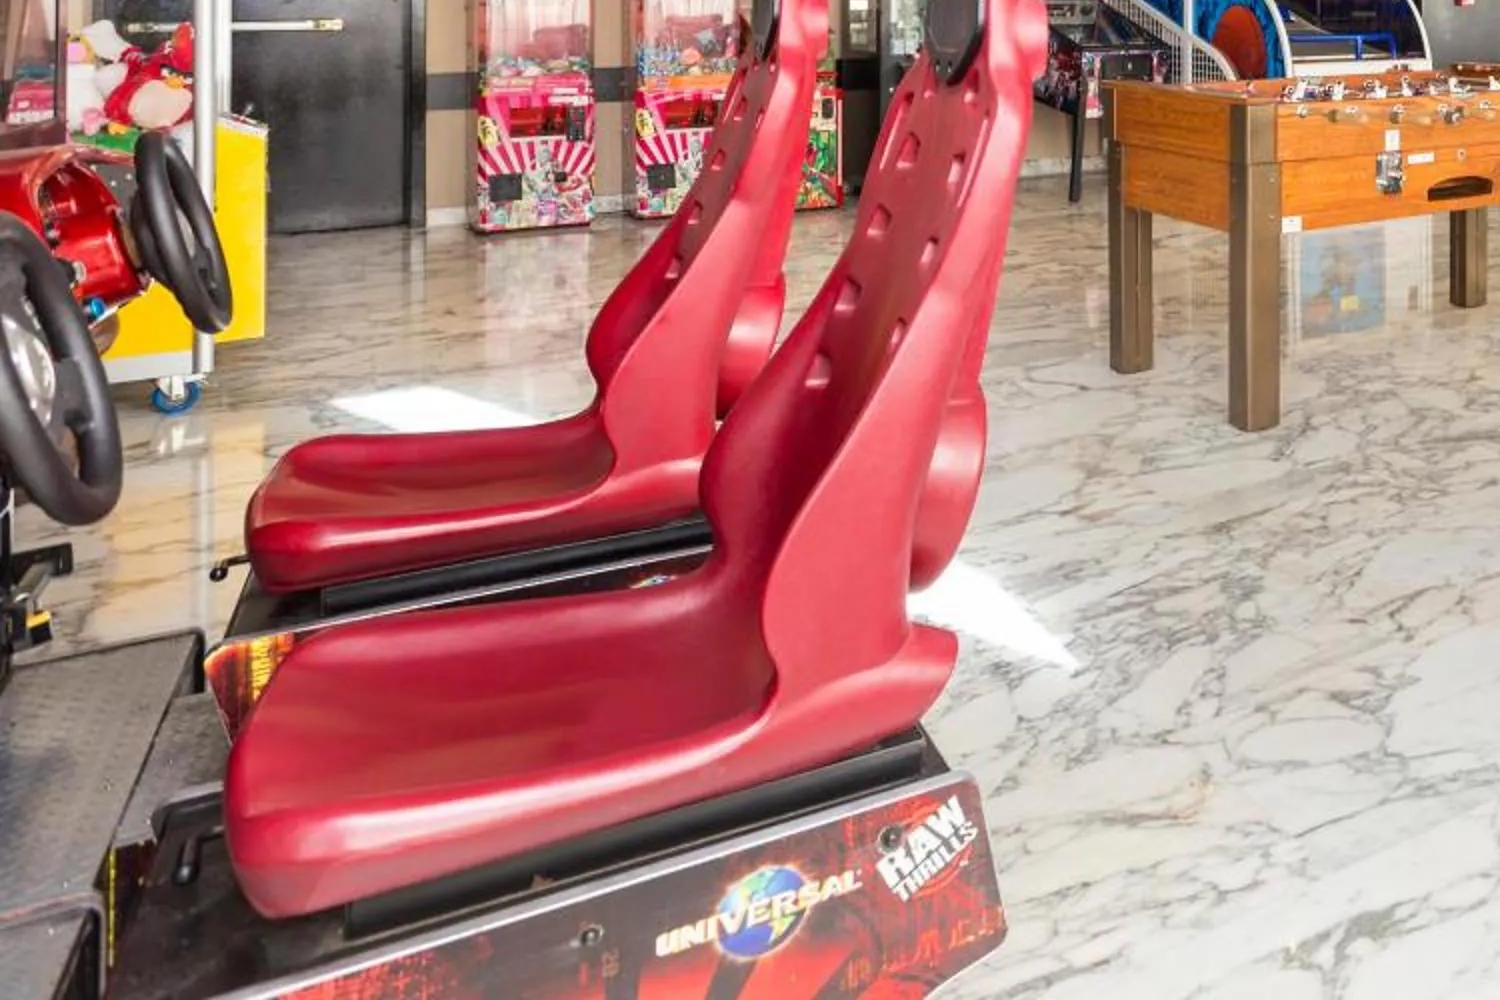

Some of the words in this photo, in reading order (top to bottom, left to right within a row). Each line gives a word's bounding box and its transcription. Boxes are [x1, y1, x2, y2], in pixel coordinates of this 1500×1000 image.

[877, 794, 969, 890] RAW
[890, 821, 979, 903] THRILLS
[655, 871, 863, 957] UNIVERSAL
